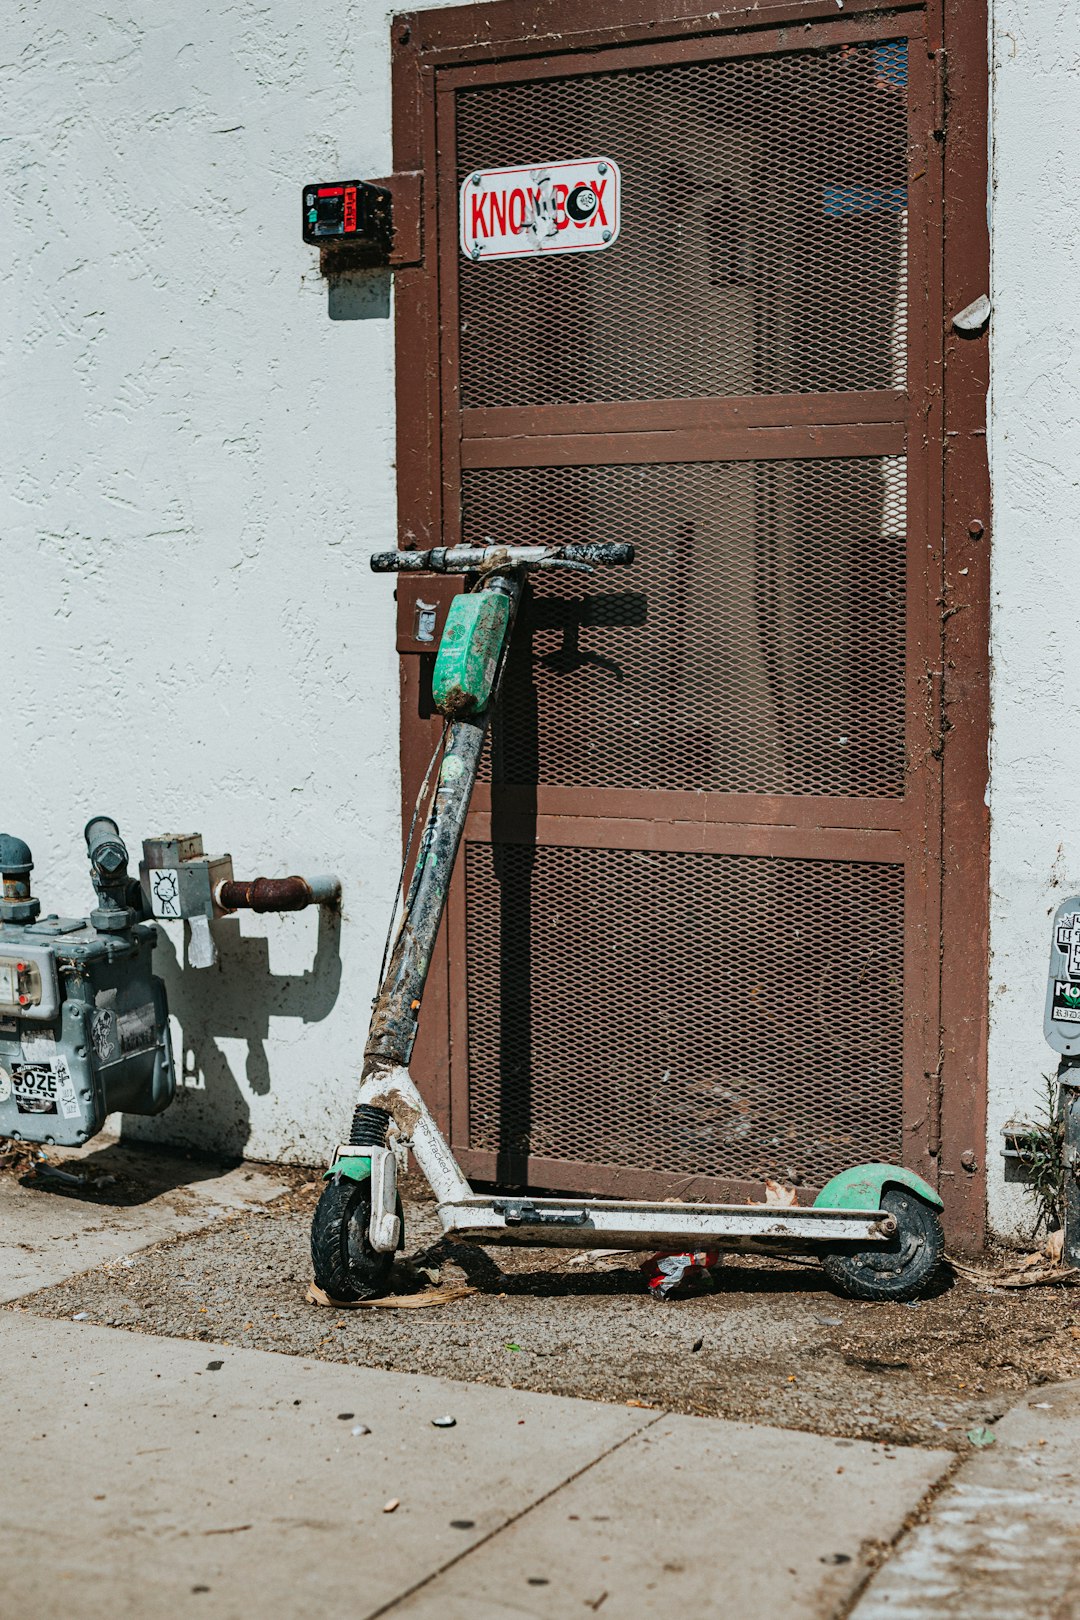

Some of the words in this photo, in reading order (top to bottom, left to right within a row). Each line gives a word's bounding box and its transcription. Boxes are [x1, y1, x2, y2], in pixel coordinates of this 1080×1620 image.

[553, 180, 608, 231] BX
[13, 1071, 57, 1092] SOZE
[15, 1086, 55, 1099] UPN
[428, 1137, 451, 1174] Tracked
